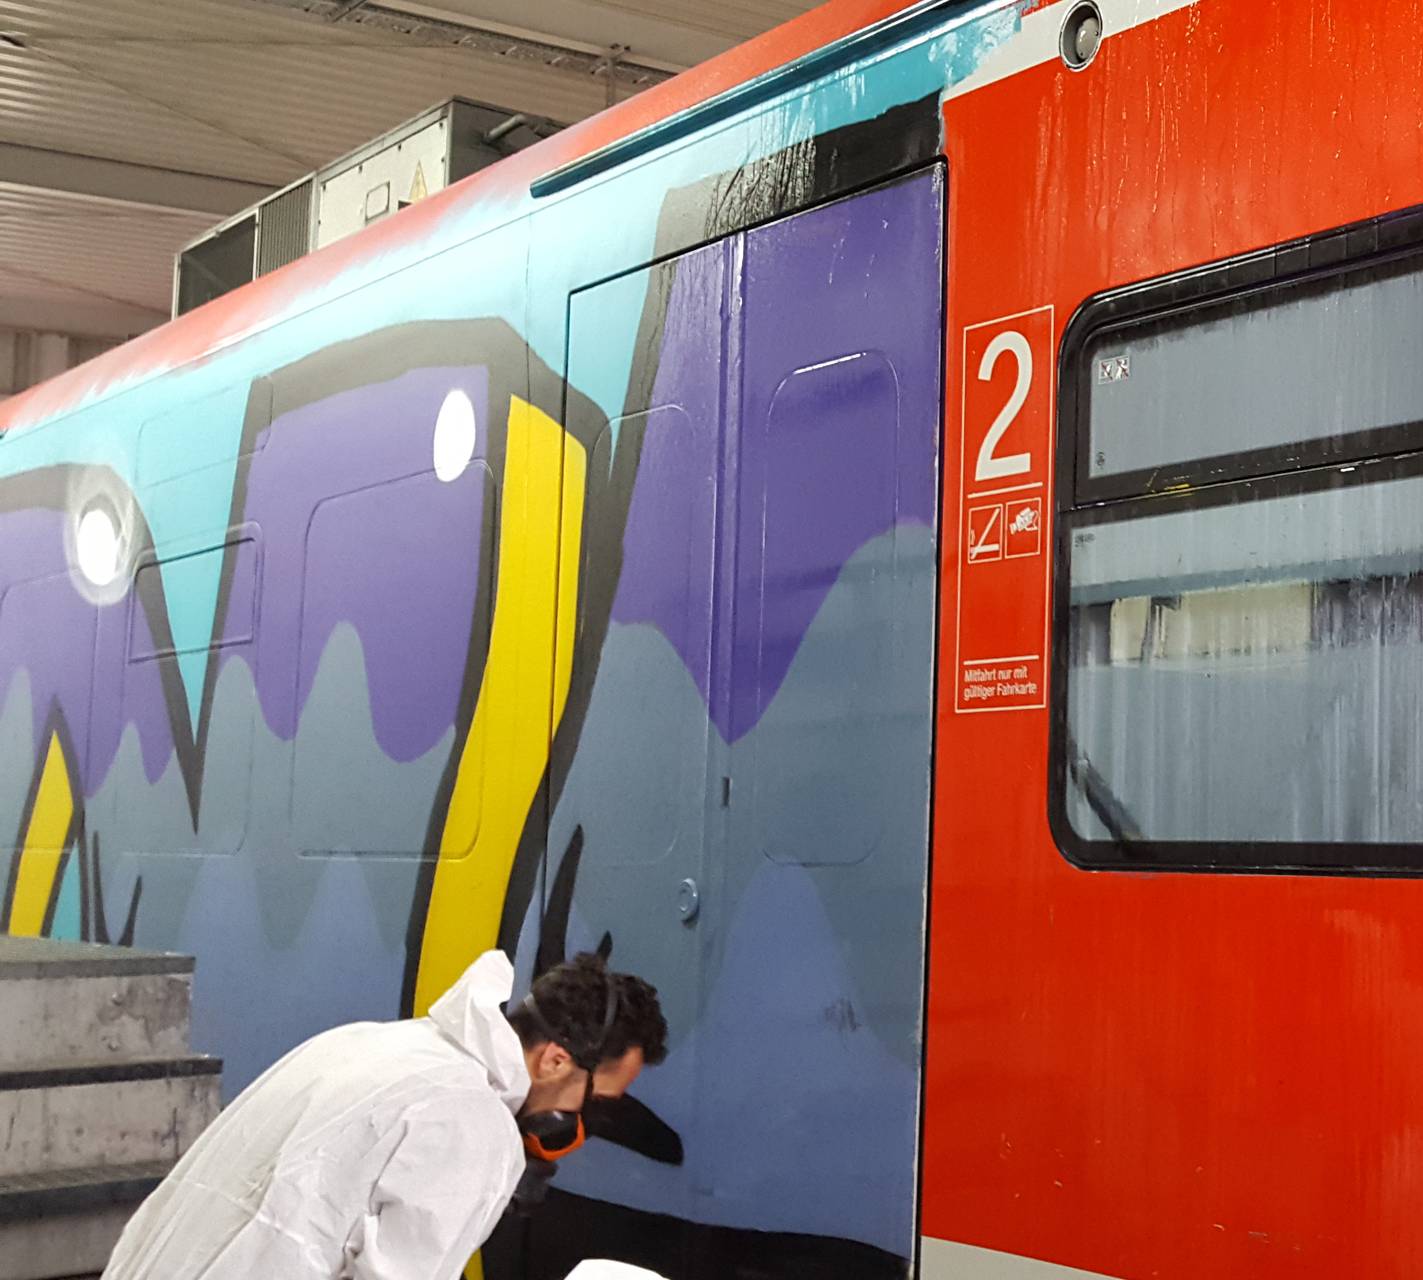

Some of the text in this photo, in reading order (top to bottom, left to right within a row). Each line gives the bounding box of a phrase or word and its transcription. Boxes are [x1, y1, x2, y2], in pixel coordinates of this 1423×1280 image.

[975, 331, 1033, 481] 2
[964, 666, 1028, 682] Mitfahrt nur mit
[963, 682, 1037, 701] gültiger Fahrkarte
